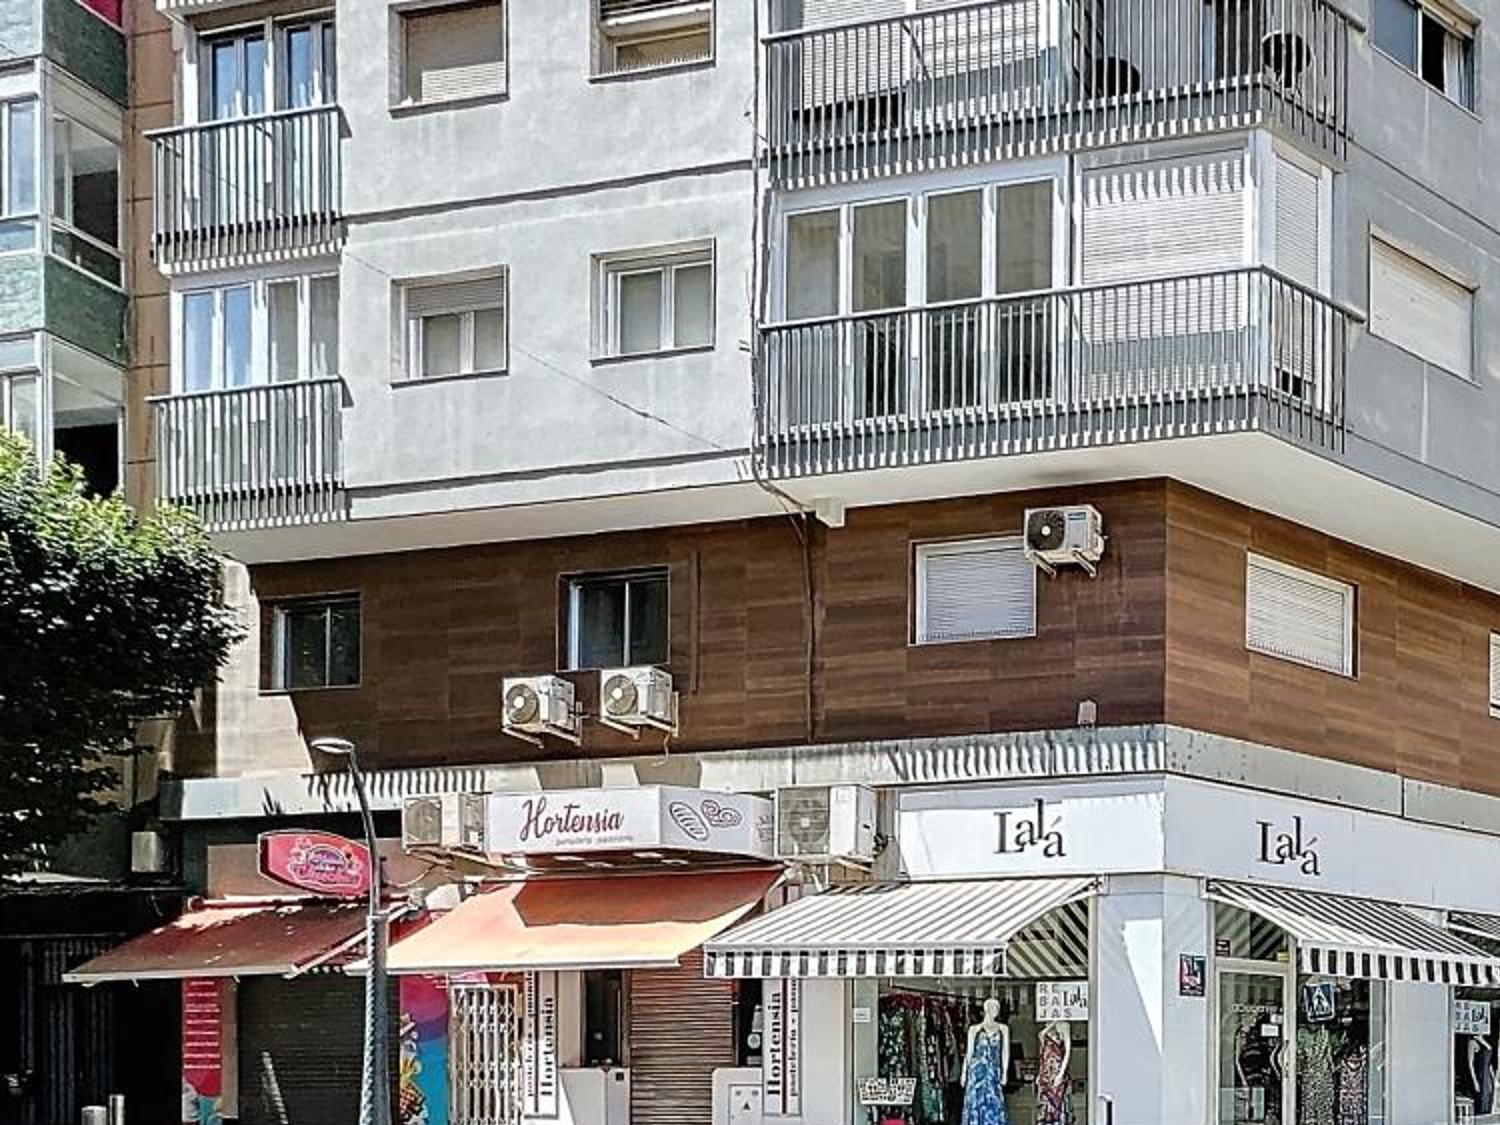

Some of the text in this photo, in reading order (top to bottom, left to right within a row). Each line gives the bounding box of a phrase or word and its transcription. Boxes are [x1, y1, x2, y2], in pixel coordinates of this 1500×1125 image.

[519, 796, 625, 842] Hortensia
[992, 797, 1067, 858] Lalá
[1255, 815, 1321, 876] Lalá
[540, 997, 553, 1096] Hortensia
[767, 992, 781, 1095] Hortensia
